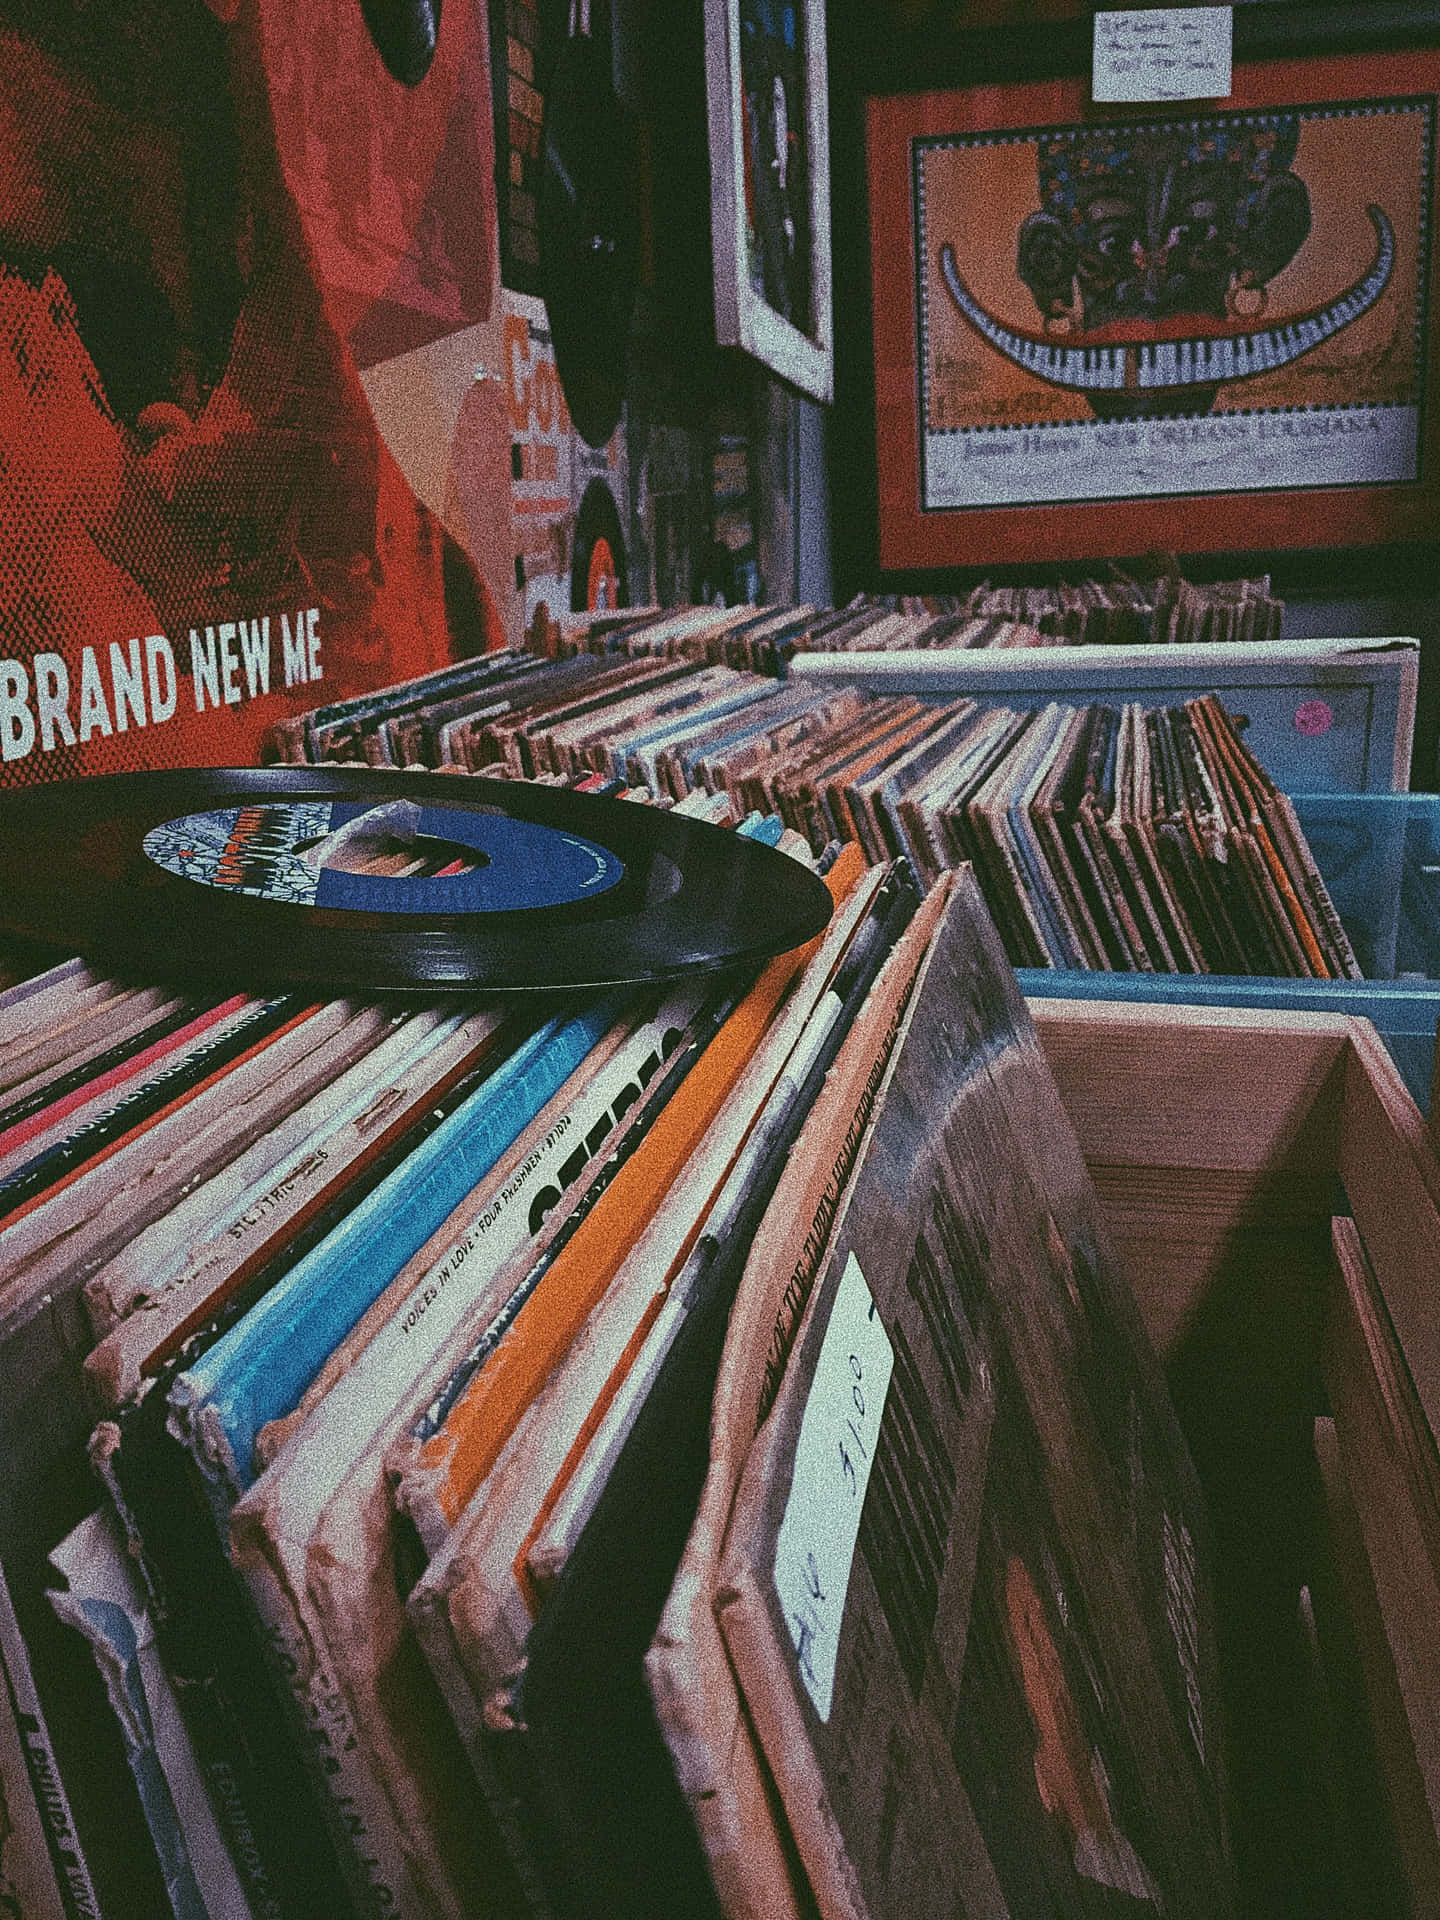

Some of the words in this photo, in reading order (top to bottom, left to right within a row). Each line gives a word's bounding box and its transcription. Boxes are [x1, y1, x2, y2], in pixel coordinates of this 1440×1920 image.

[0, 635, 177, 762] BRAND
[190, 616, 270, 713] NEW
[281, 608, 324, 688] ME
[401, 1288, 437, 1333] VOICES
[437, 1267, 451, 1286] IN
[450, 1240, 475, 1269] LOVE
[477, 1203, 502, 1233] FOUR
[31, 1747, 74, 1841] PHILIPS
